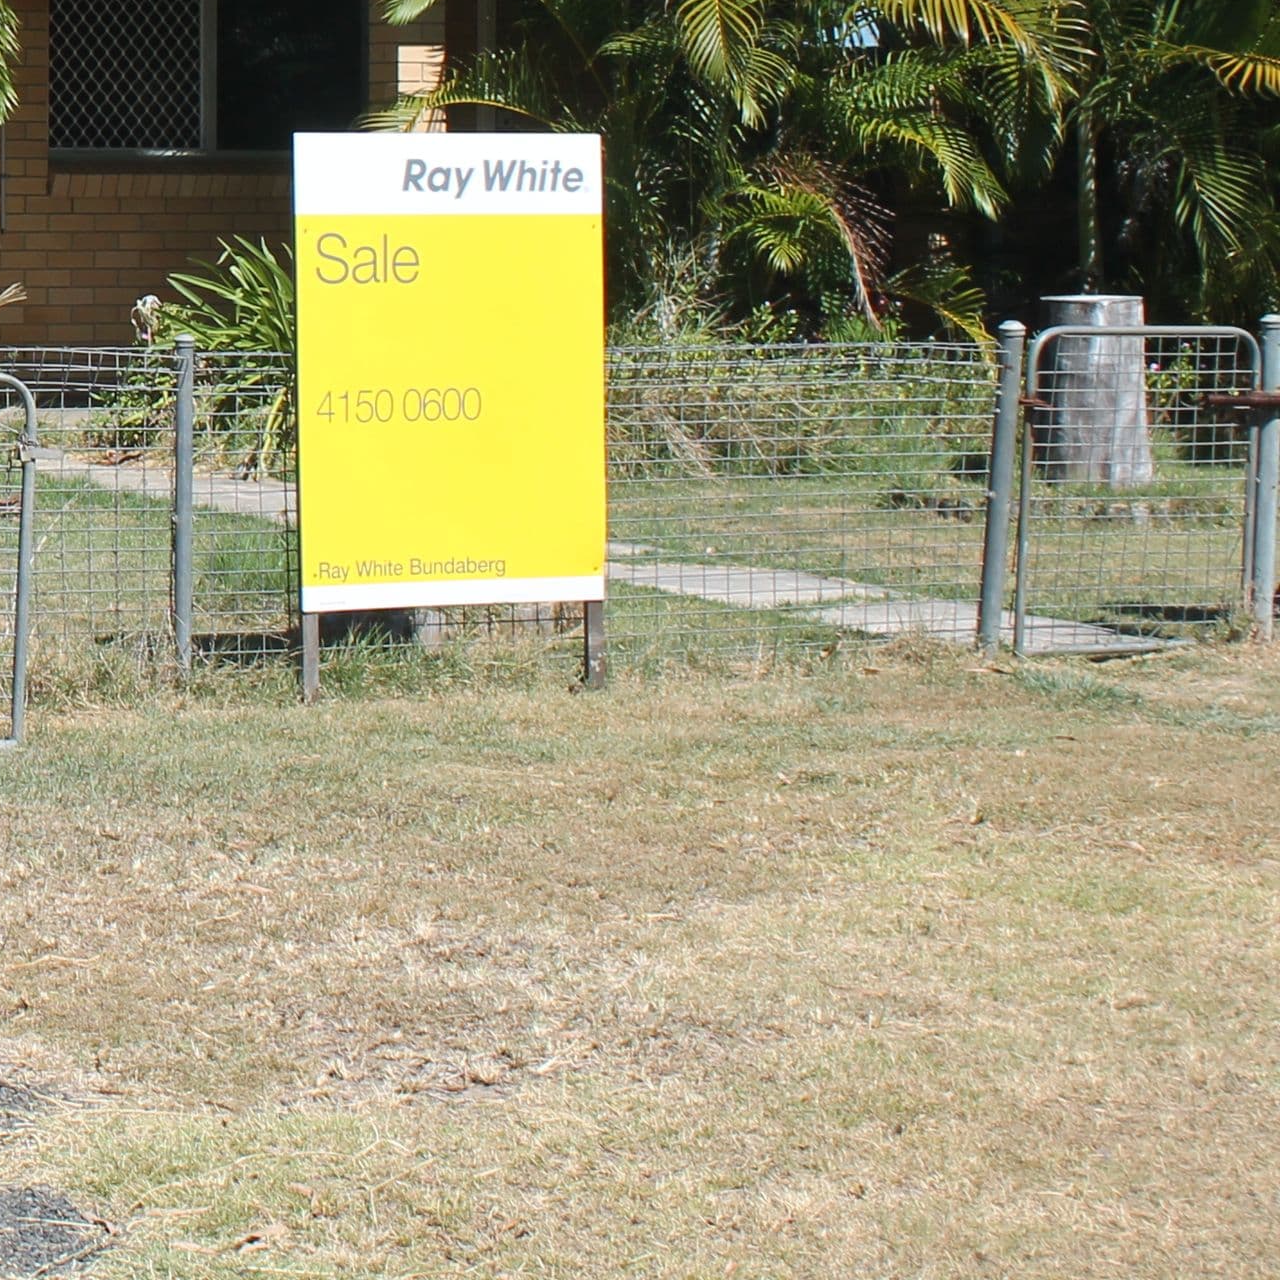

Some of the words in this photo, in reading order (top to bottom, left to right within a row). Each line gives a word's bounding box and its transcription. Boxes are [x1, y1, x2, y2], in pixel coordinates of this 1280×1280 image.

[402, 158, 474, 199] Ray
[482, 159, 584, 192] White
[315, 232, 420, 284] Sale
[316, 389, 394, 422] 4150
[402, 388, 482, 422] 0600
[319, 561, 350, 582] Ray
[356, 559, 404, 577] White
[409, 556, 507, 577] Bundaberg
